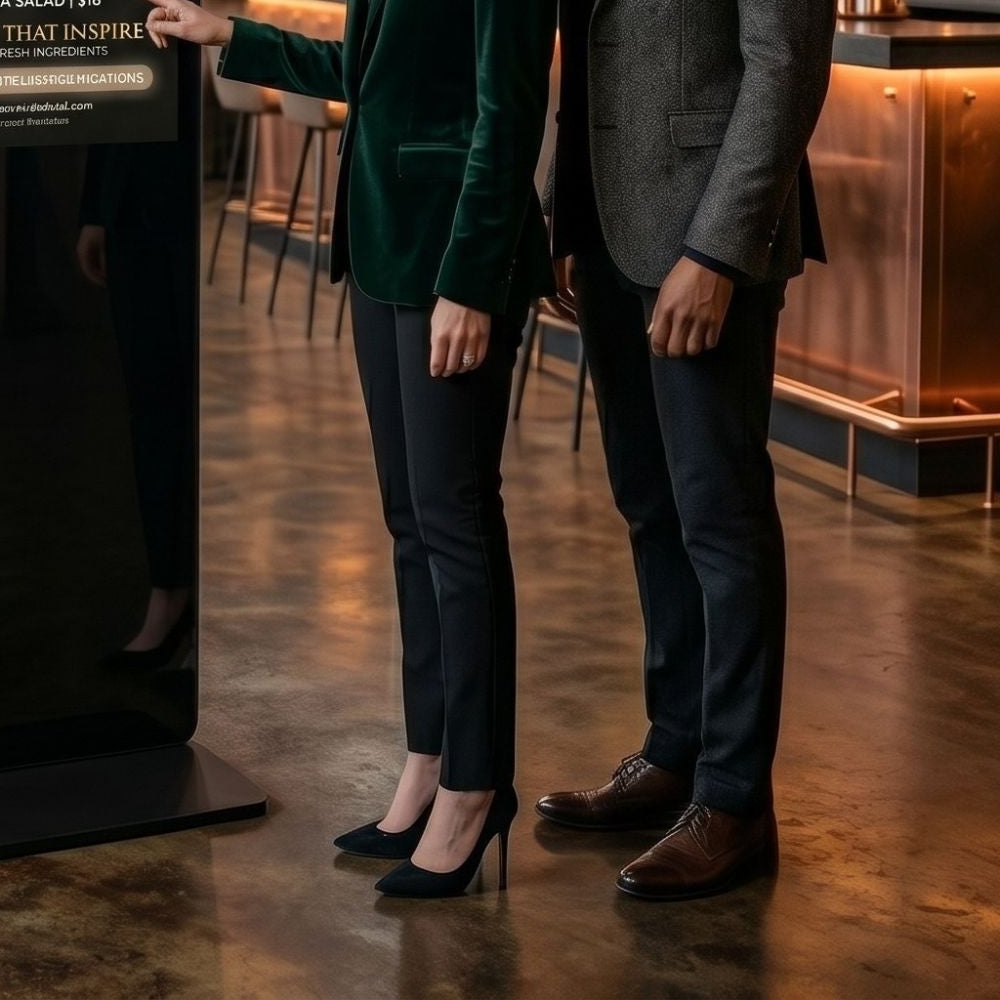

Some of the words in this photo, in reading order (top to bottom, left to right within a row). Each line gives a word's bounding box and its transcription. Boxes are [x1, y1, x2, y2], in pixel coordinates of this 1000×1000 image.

[3, 24, 59, 41] THAT
[63, 22, 144, 40] INSPIRE
[33, 45, 108, 57] INGREDIENTS
